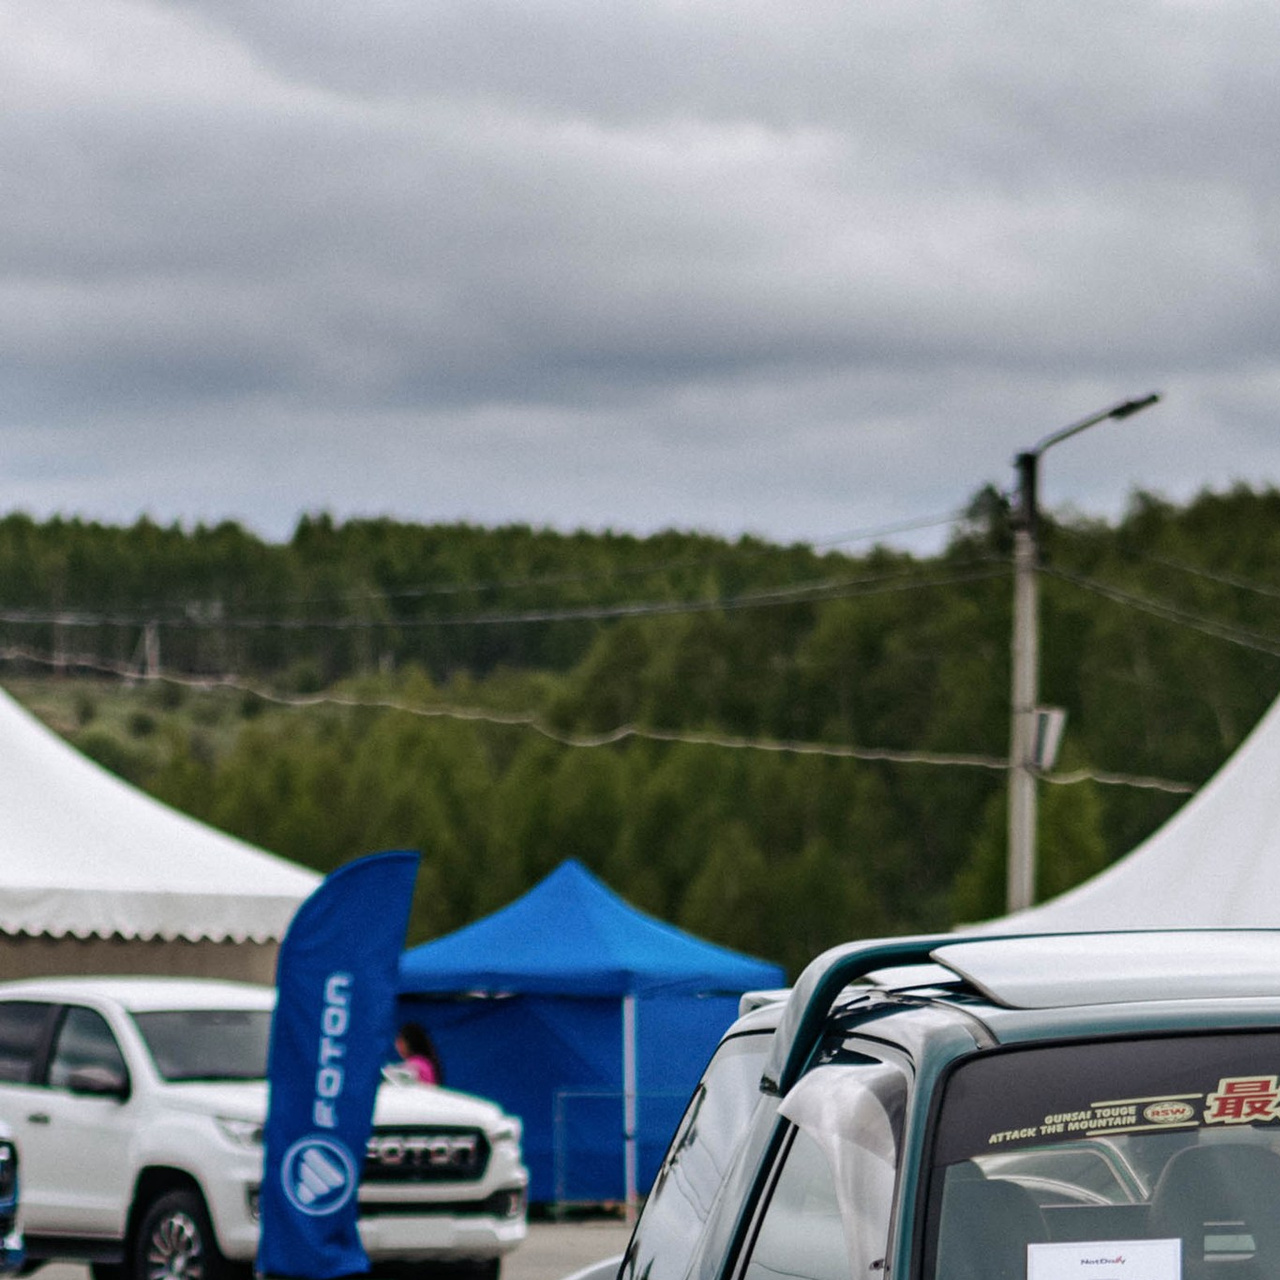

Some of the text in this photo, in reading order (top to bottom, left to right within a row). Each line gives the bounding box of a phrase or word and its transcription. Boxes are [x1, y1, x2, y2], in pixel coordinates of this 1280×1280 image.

[313, 973, 351, 1129] FOTON
[1044, 1105, 1137, 1125] GUNSAI TOUGE
[1150, 1107, 1187, 1117] RSW
[988, 1115, 1137, 1144] ATTACK THE MOUNTAIN
